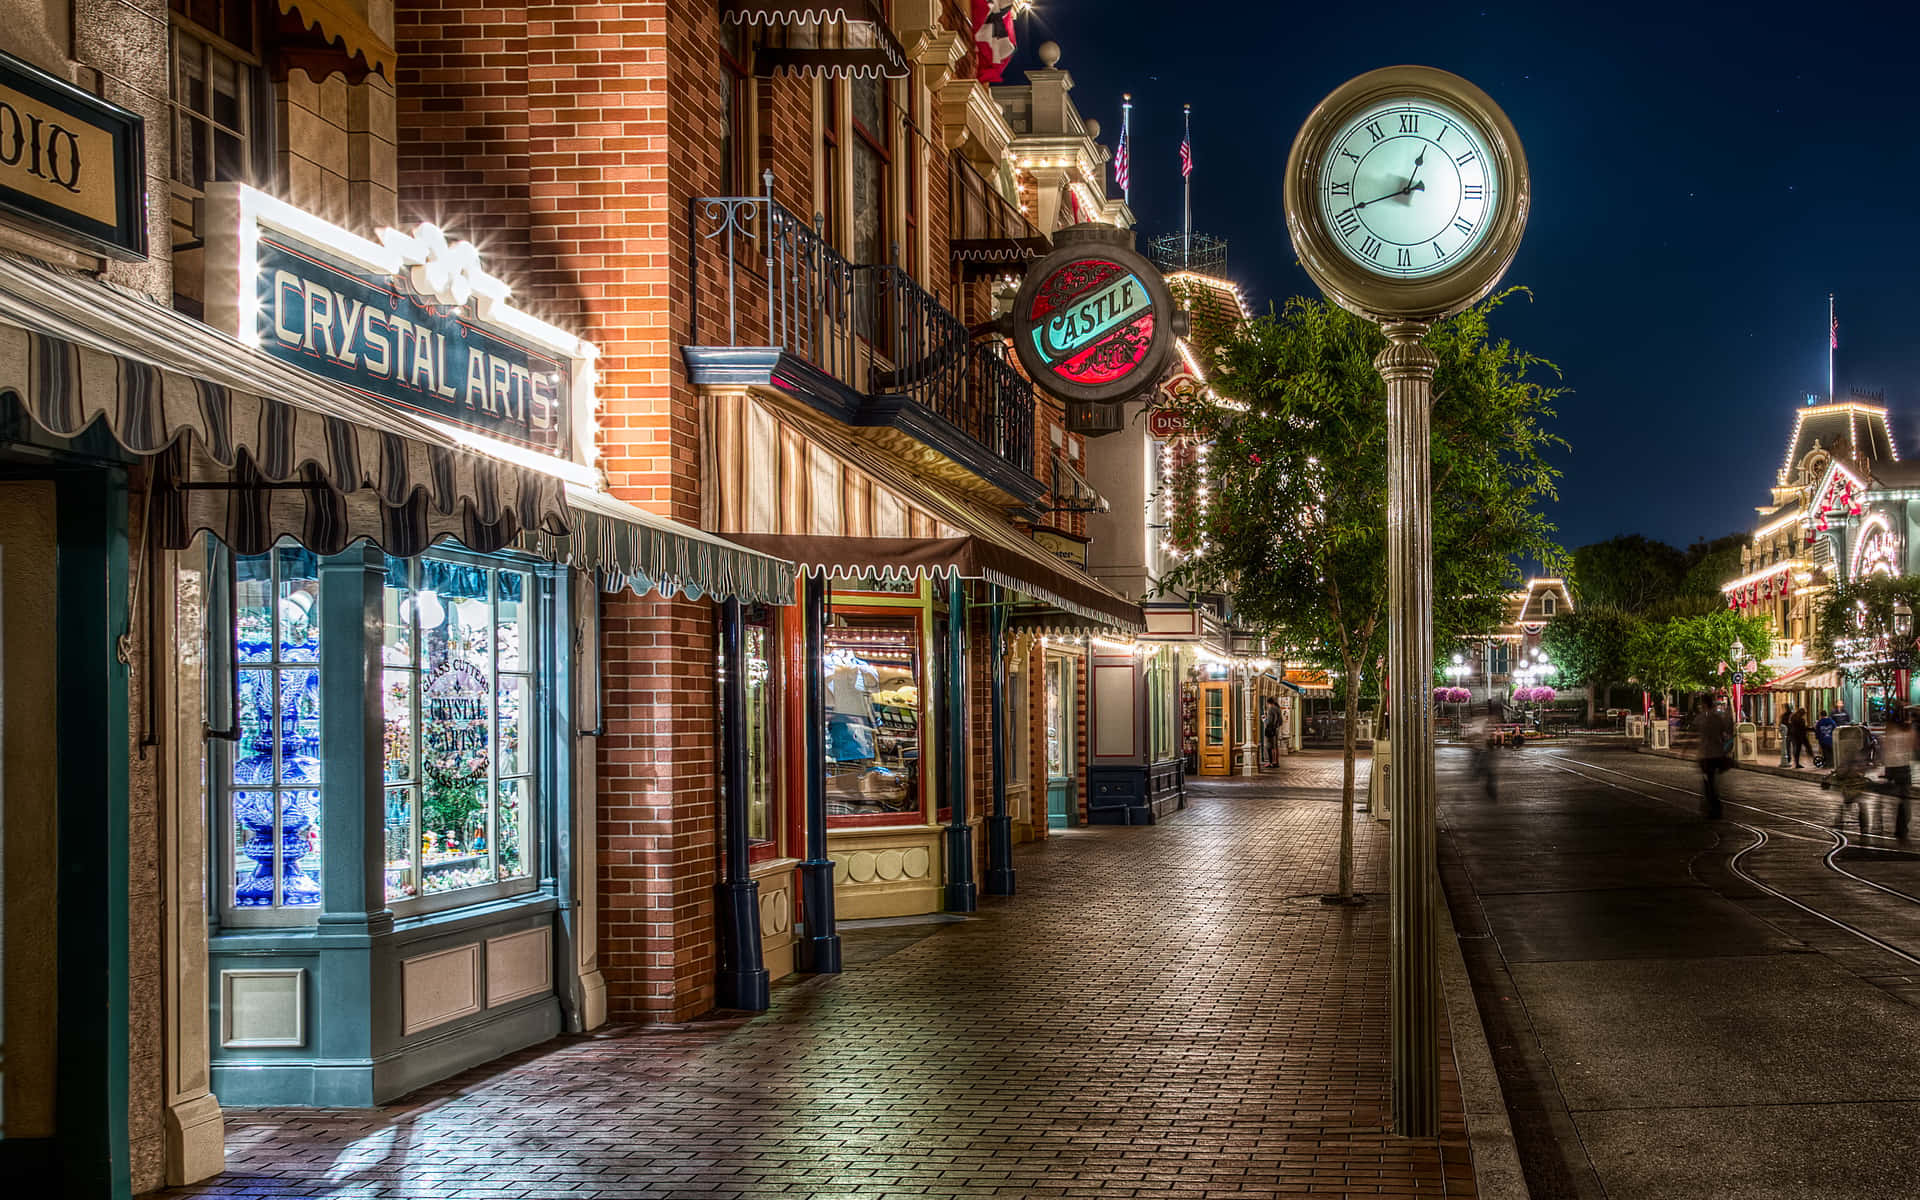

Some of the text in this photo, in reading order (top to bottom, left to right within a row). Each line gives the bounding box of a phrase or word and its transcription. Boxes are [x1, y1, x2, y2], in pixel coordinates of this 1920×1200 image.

[1366, 121, 1385, 143] XI
[1399, 114, 1419, 133] XII
[1437, 125, 1449, 142] I
[1341, 147, 1360, 164] X
[1456, 150, 1475, 167] II
[1331, 181, 1349, 196] IX
[1464, 184, 1482, 200] III
[1454, 216, 1473, 236] IV
[1359, 236, 1382, 260] VII
[1397, 248, 1411, 266] VI
[1432, 241, 1446, 259] V
[1041, 279, 1135, 357] CASTLE
[275, 270, 550, 429] CRYSTAL ARTS
[423, 658, 490, 695] GLASS CUTTERS
[430, 698, 487, 720] CRYSTAL
[441, 727, 476, 752] ARTS
